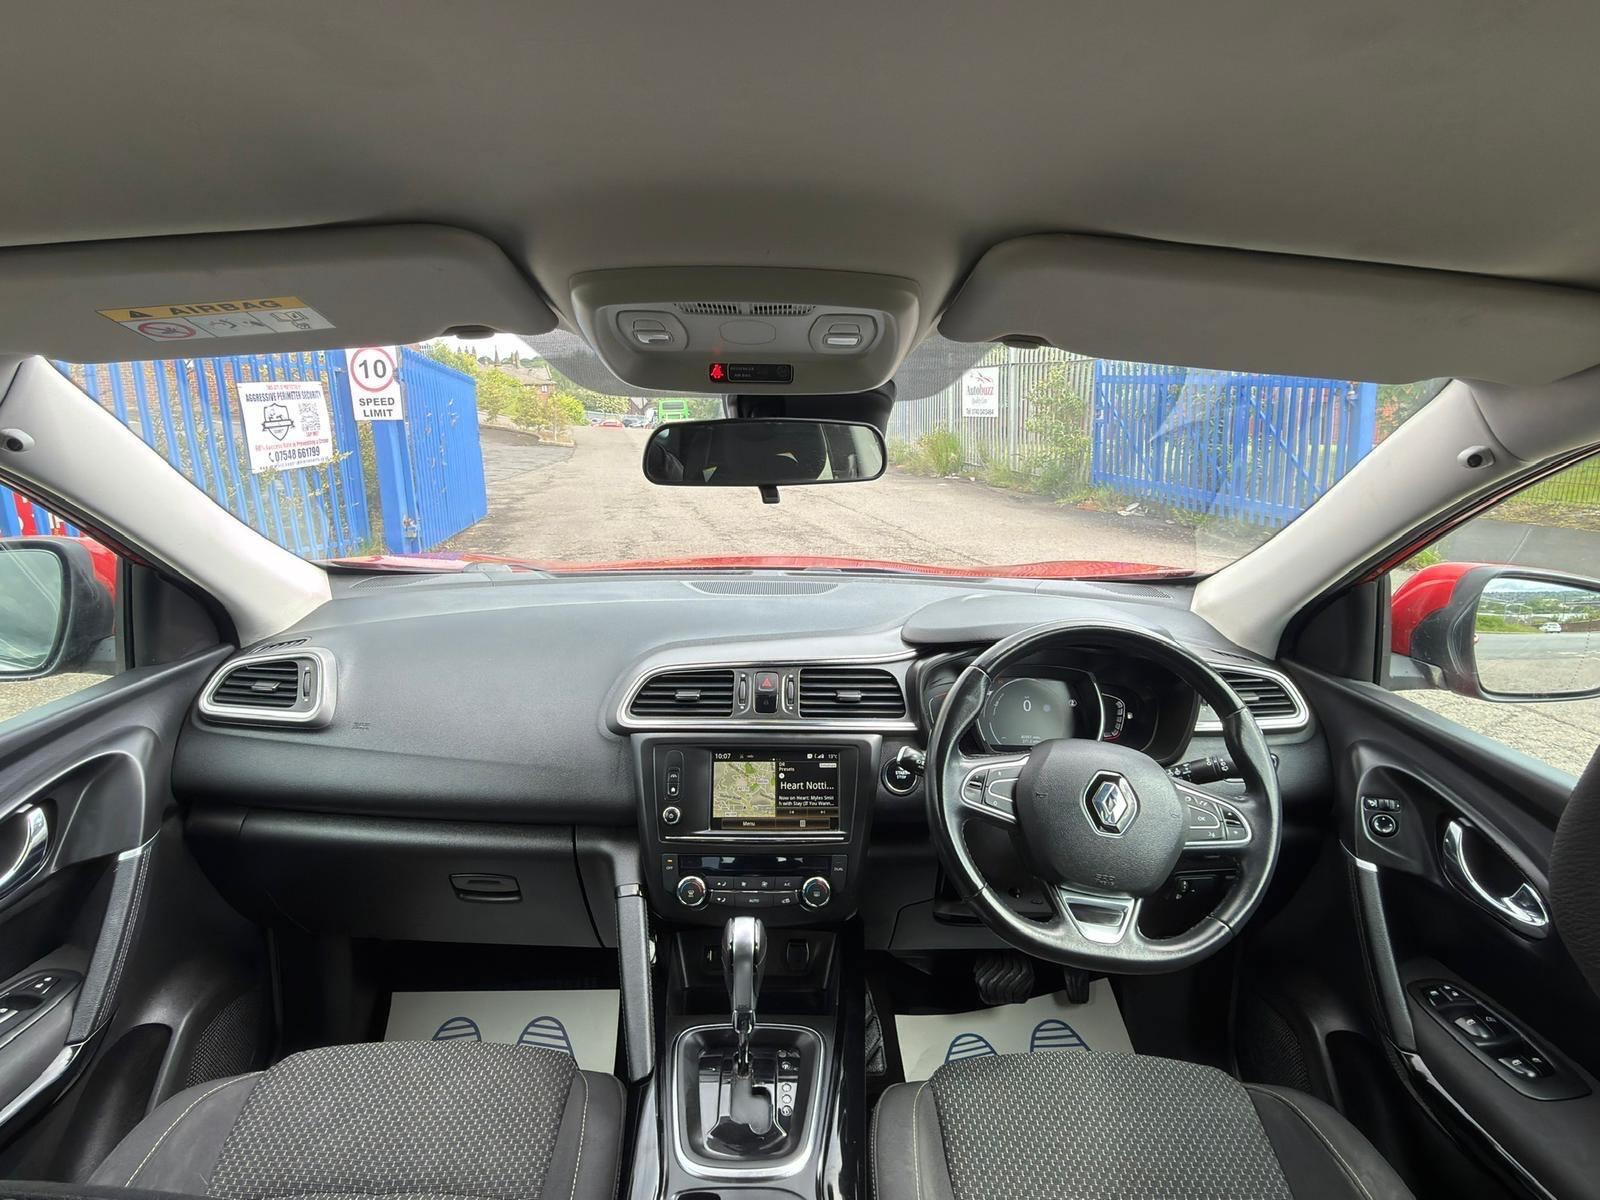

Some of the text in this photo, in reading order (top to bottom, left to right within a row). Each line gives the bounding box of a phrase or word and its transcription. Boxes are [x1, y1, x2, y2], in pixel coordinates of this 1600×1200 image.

[169, 299, 282, 316] AIRBAG
[358, 359, 387, 379] 10
[245, 390, 321, 403] AGGRESSIVE PERIMETER SECURITY
[359, 397, 395, 407] SPEED
[363, 409, 393, 418] LIMIT
[274, 446, 321, 462] 07548 661799
[1023, 699, 1032, 712] 0
[780, 781, 835, 790] Heart Notti...
